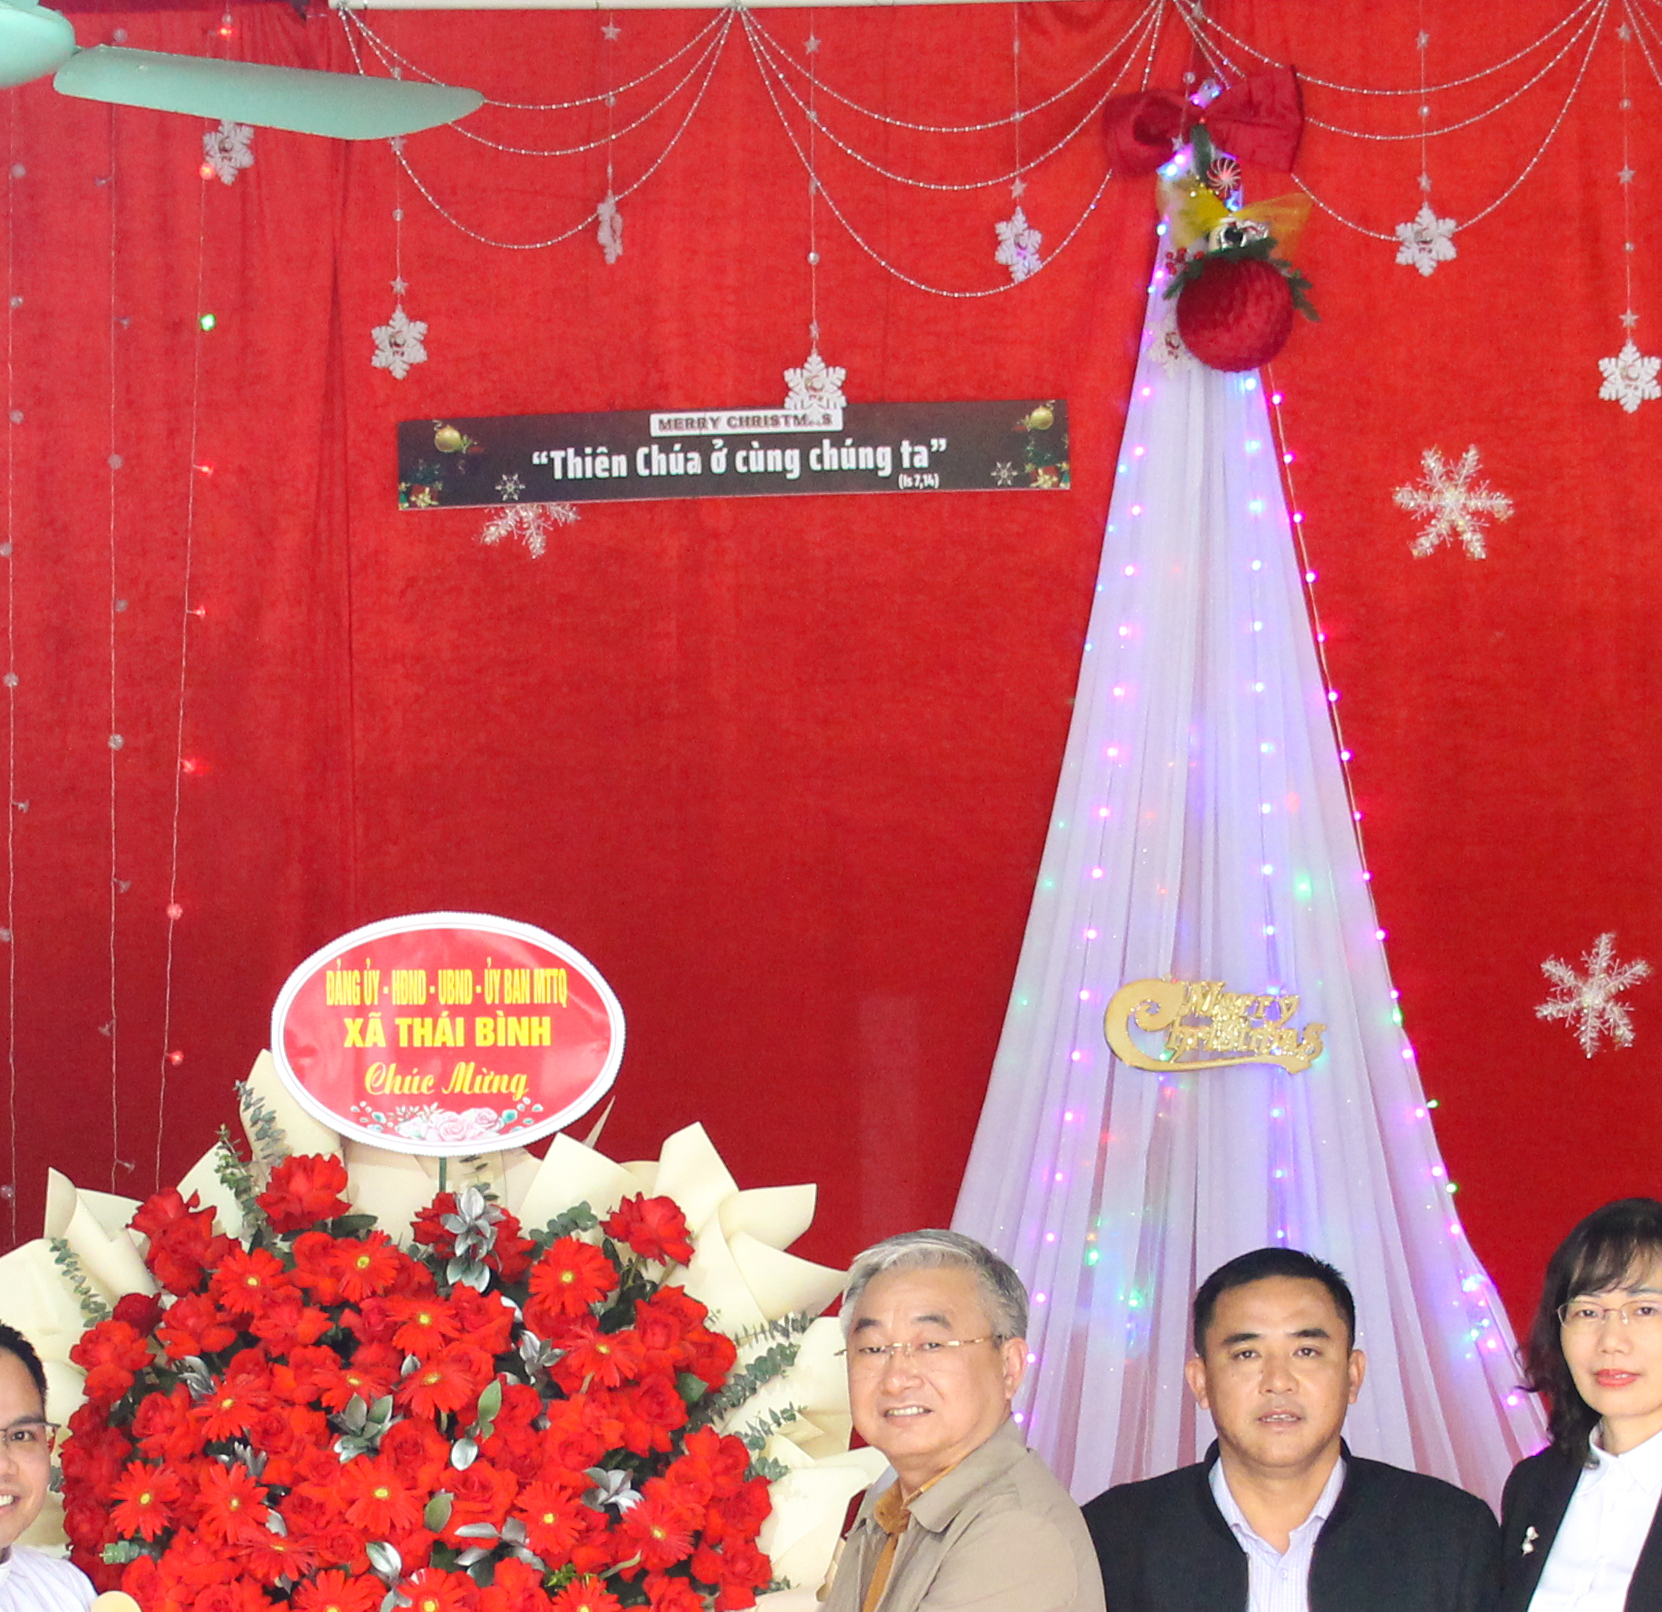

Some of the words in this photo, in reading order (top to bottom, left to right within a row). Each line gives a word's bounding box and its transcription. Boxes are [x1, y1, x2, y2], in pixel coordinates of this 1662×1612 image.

[657, 416, 722, 432] MERRY
[726, 412, 834, 429] CHRISTMS
[636, 442, 703, 477] Chúa
[709, 438, 729, 475] ở
[735, 440, 802, 480] cùng
[808, 436, 892, 477] chúng
[325, 957, 362, 1006] ĐẢNG
[363, 957, 381, 1006] ỦY
[391, 969, 428, 1006] HĐND
[437, 968, 474, 1006] UBND
[483, 956, 501, 1005] ỦY
[503, 968, 531, 1005] BAN
[533, 967, 568, 1008] MTTQ
[1180, 980, 1301, 1026] Merry
[343, 1011, 387, 1048] XÃ
[394, 1010, 466, 1048] THÁI
[474, 1010, 552, 1047] BÌNH
[364, 1061, 436, 1095] Chúc
[441, 1061, 530, 1101] Mừng
